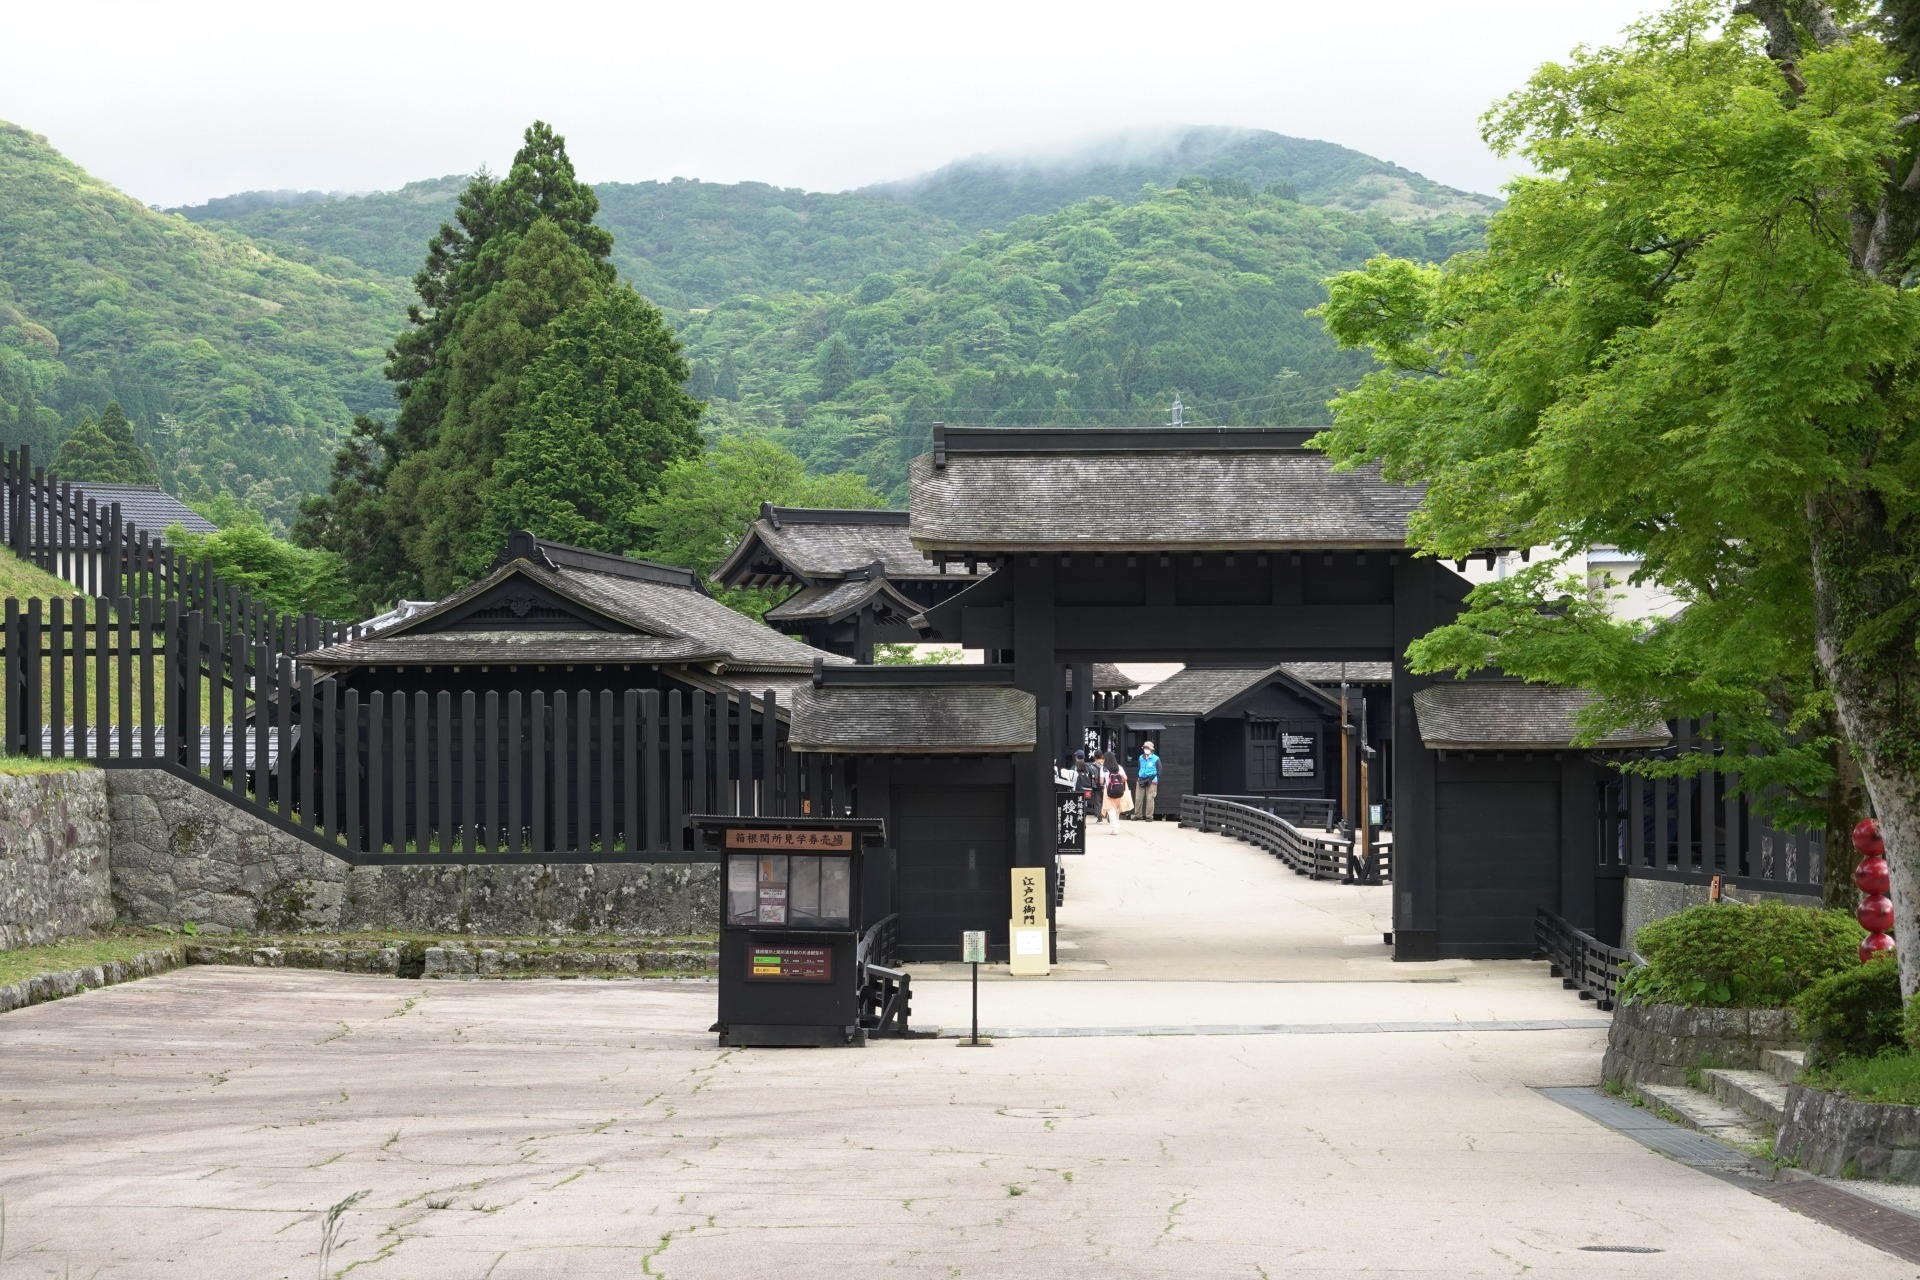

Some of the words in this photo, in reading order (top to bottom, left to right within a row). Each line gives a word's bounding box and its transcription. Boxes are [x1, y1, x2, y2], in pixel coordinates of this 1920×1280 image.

[735, 832, 844, 846] 箱根関所見学券売場
[1062, 799, 1078, 844] 検札所
[1023, 876, 1035, 925] 江戸口御門
